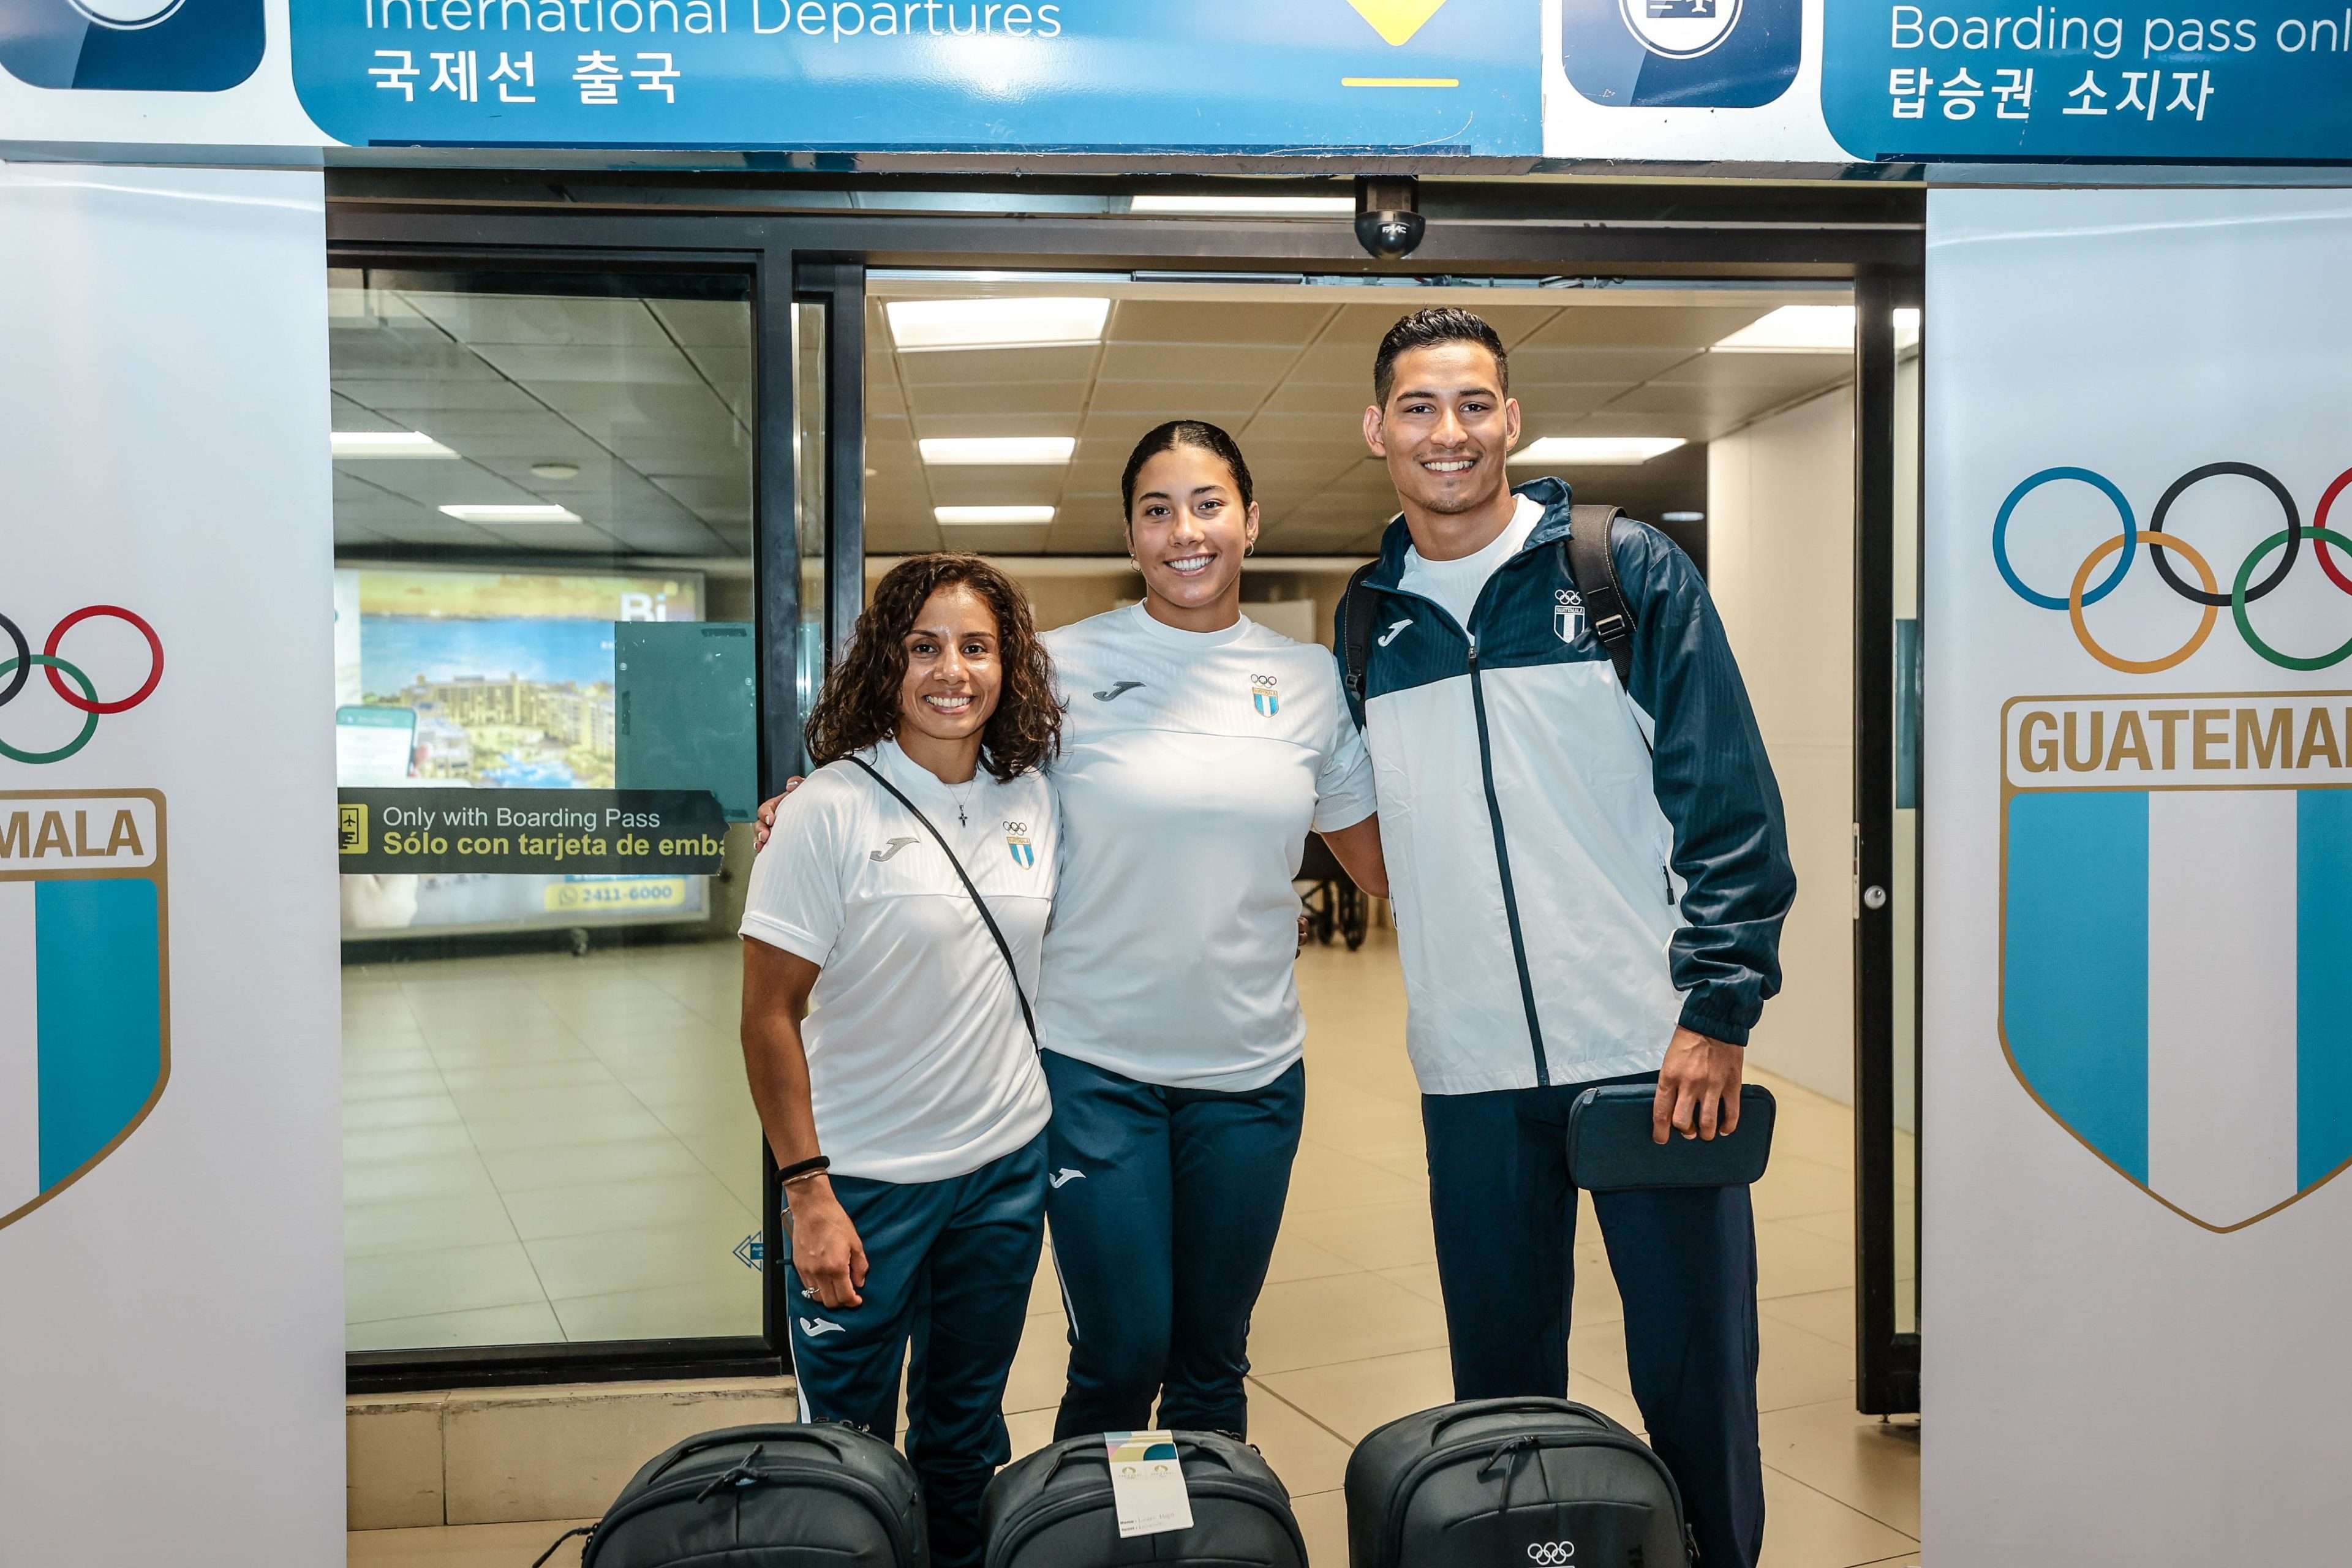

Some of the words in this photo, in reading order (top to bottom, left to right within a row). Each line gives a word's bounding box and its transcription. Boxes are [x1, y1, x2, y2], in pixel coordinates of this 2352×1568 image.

[753, 0, 1062, 43] Departures
[1891, 4, 2123, 59] Boarding
[2144, 18, 2258, 59] pass
[368, 50, 537, 103] 국제선
[572, 50, 681, 104] 출국
[1889, 67, 2034, 120] 탑승권
[2062, 70, 2214, 121] 소지자
[383, 807, 435, 830] Only
[442, 807, 488, 826] with
[497, 808, 597, 831] Boarding
[606, 809, 660, 827] Pass
[383, 831, 448, 854] Sólo
[457, 837, 509, 855] con
[518, 832, 607, 861] tarjeta
[616, 834, 649, 856] de
